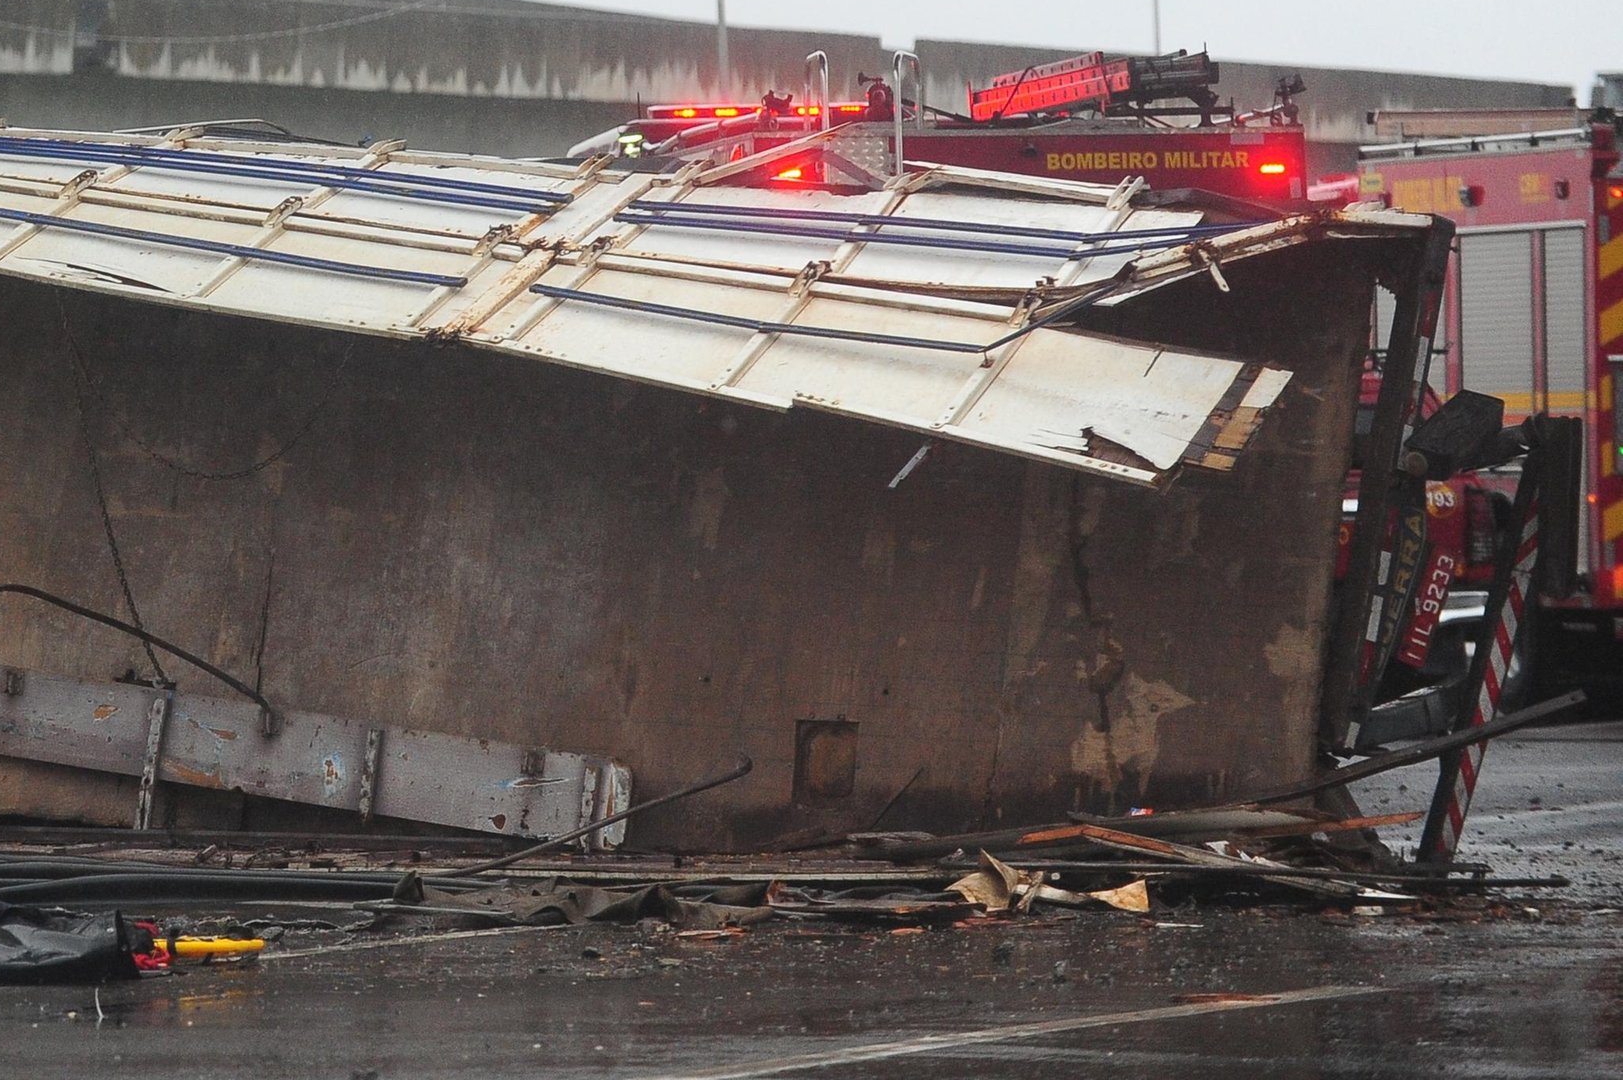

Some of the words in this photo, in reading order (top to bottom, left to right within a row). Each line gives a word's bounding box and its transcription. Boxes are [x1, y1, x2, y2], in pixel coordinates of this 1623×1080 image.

[1046, 151, 1158, 170] BOMBEIRO
[1164, 151, 1250, 168] MILITAR
[1426, 491, 1455, 507] 193
[1422, 554, 1455, 615] 9233
